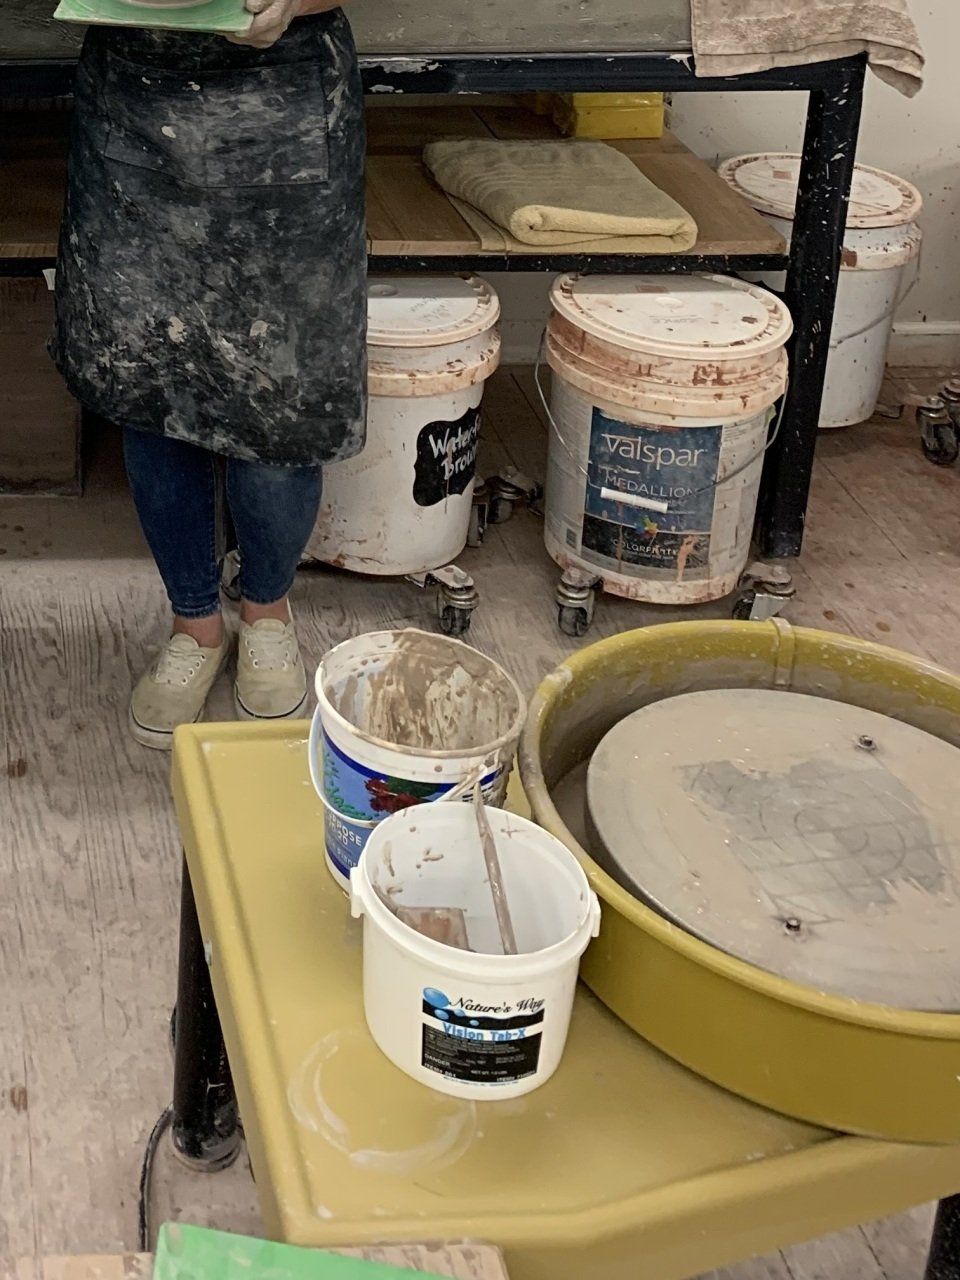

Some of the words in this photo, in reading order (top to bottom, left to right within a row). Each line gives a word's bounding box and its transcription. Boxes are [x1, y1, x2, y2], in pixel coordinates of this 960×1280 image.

[601, 433, 705, 470] valspar
[449, 997, 512, 1013] Nature's
[516, 997, 545, 1011] Way
[442, 1022, 484, 1041] Vision
[490, 1027, 526, 1042] Tab-X
